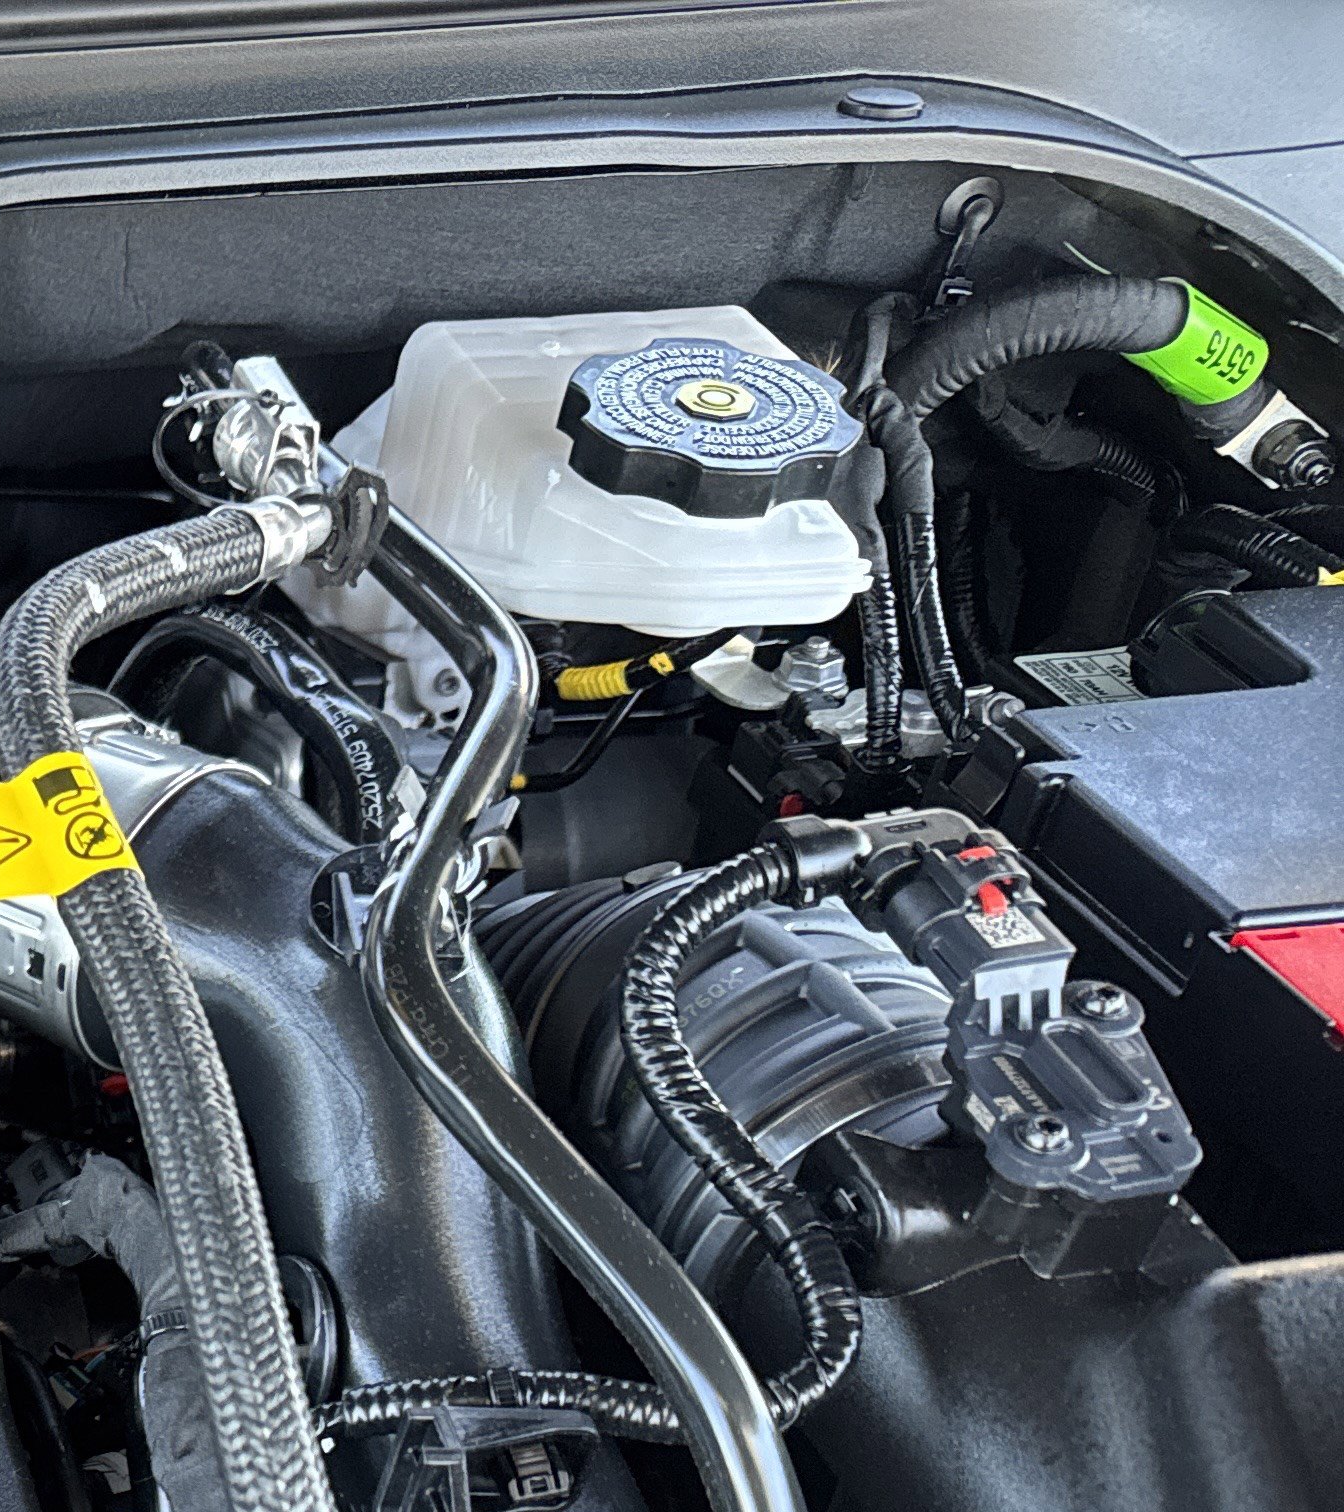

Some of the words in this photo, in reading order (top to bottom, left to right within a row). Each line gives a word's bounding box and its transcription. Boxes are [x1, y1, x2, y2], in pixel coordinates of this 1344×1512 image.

[635, 348, 682, 361] FLUID
[689, 348, 725, 358] DOT
[603, 355, 644, 373] FROM
[633, 356, 692, 375] BEFORE
[689, 356, 725, 367] CAP
[595, 376, 620, 405] SEALED
[703, 432, 732, 445] DOT
[728, 434, 773, 445] FREIN
[753, 439, 798, 453] AVANT
[333, 710, 360, 740] 515
[348, 739, 383, 830] 25207409
